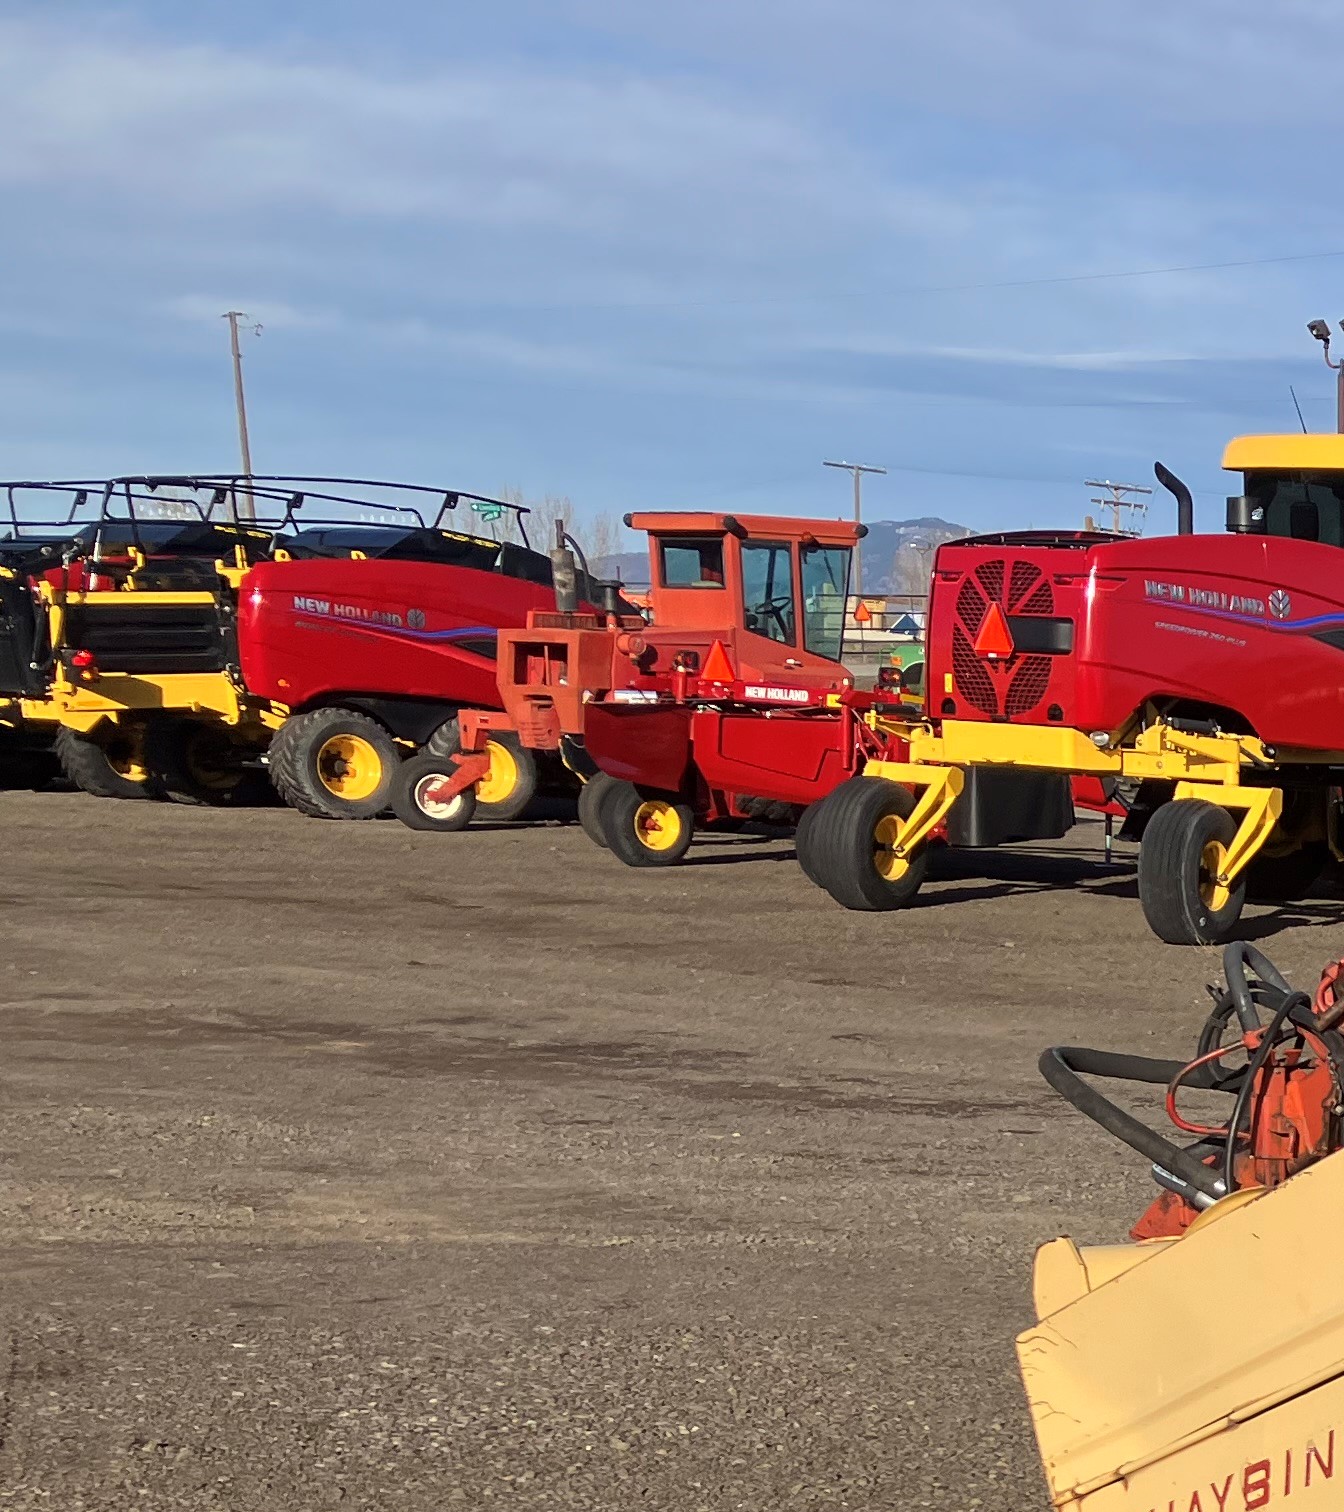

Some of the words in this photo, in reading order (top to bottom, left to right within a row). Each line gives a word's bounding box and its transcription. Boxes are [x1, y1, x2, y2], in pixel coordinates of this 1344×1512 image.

[294, 596, 330, 614] NEW
[334, 604, 402, 626] HOLLAND
[1144, 579, 1184, 600] NEW
[1189, 587, 1265, 615] HOLLAND
[745, 686, 766, 698] NEW
[767, 687, 808, 701] HOLLAND
